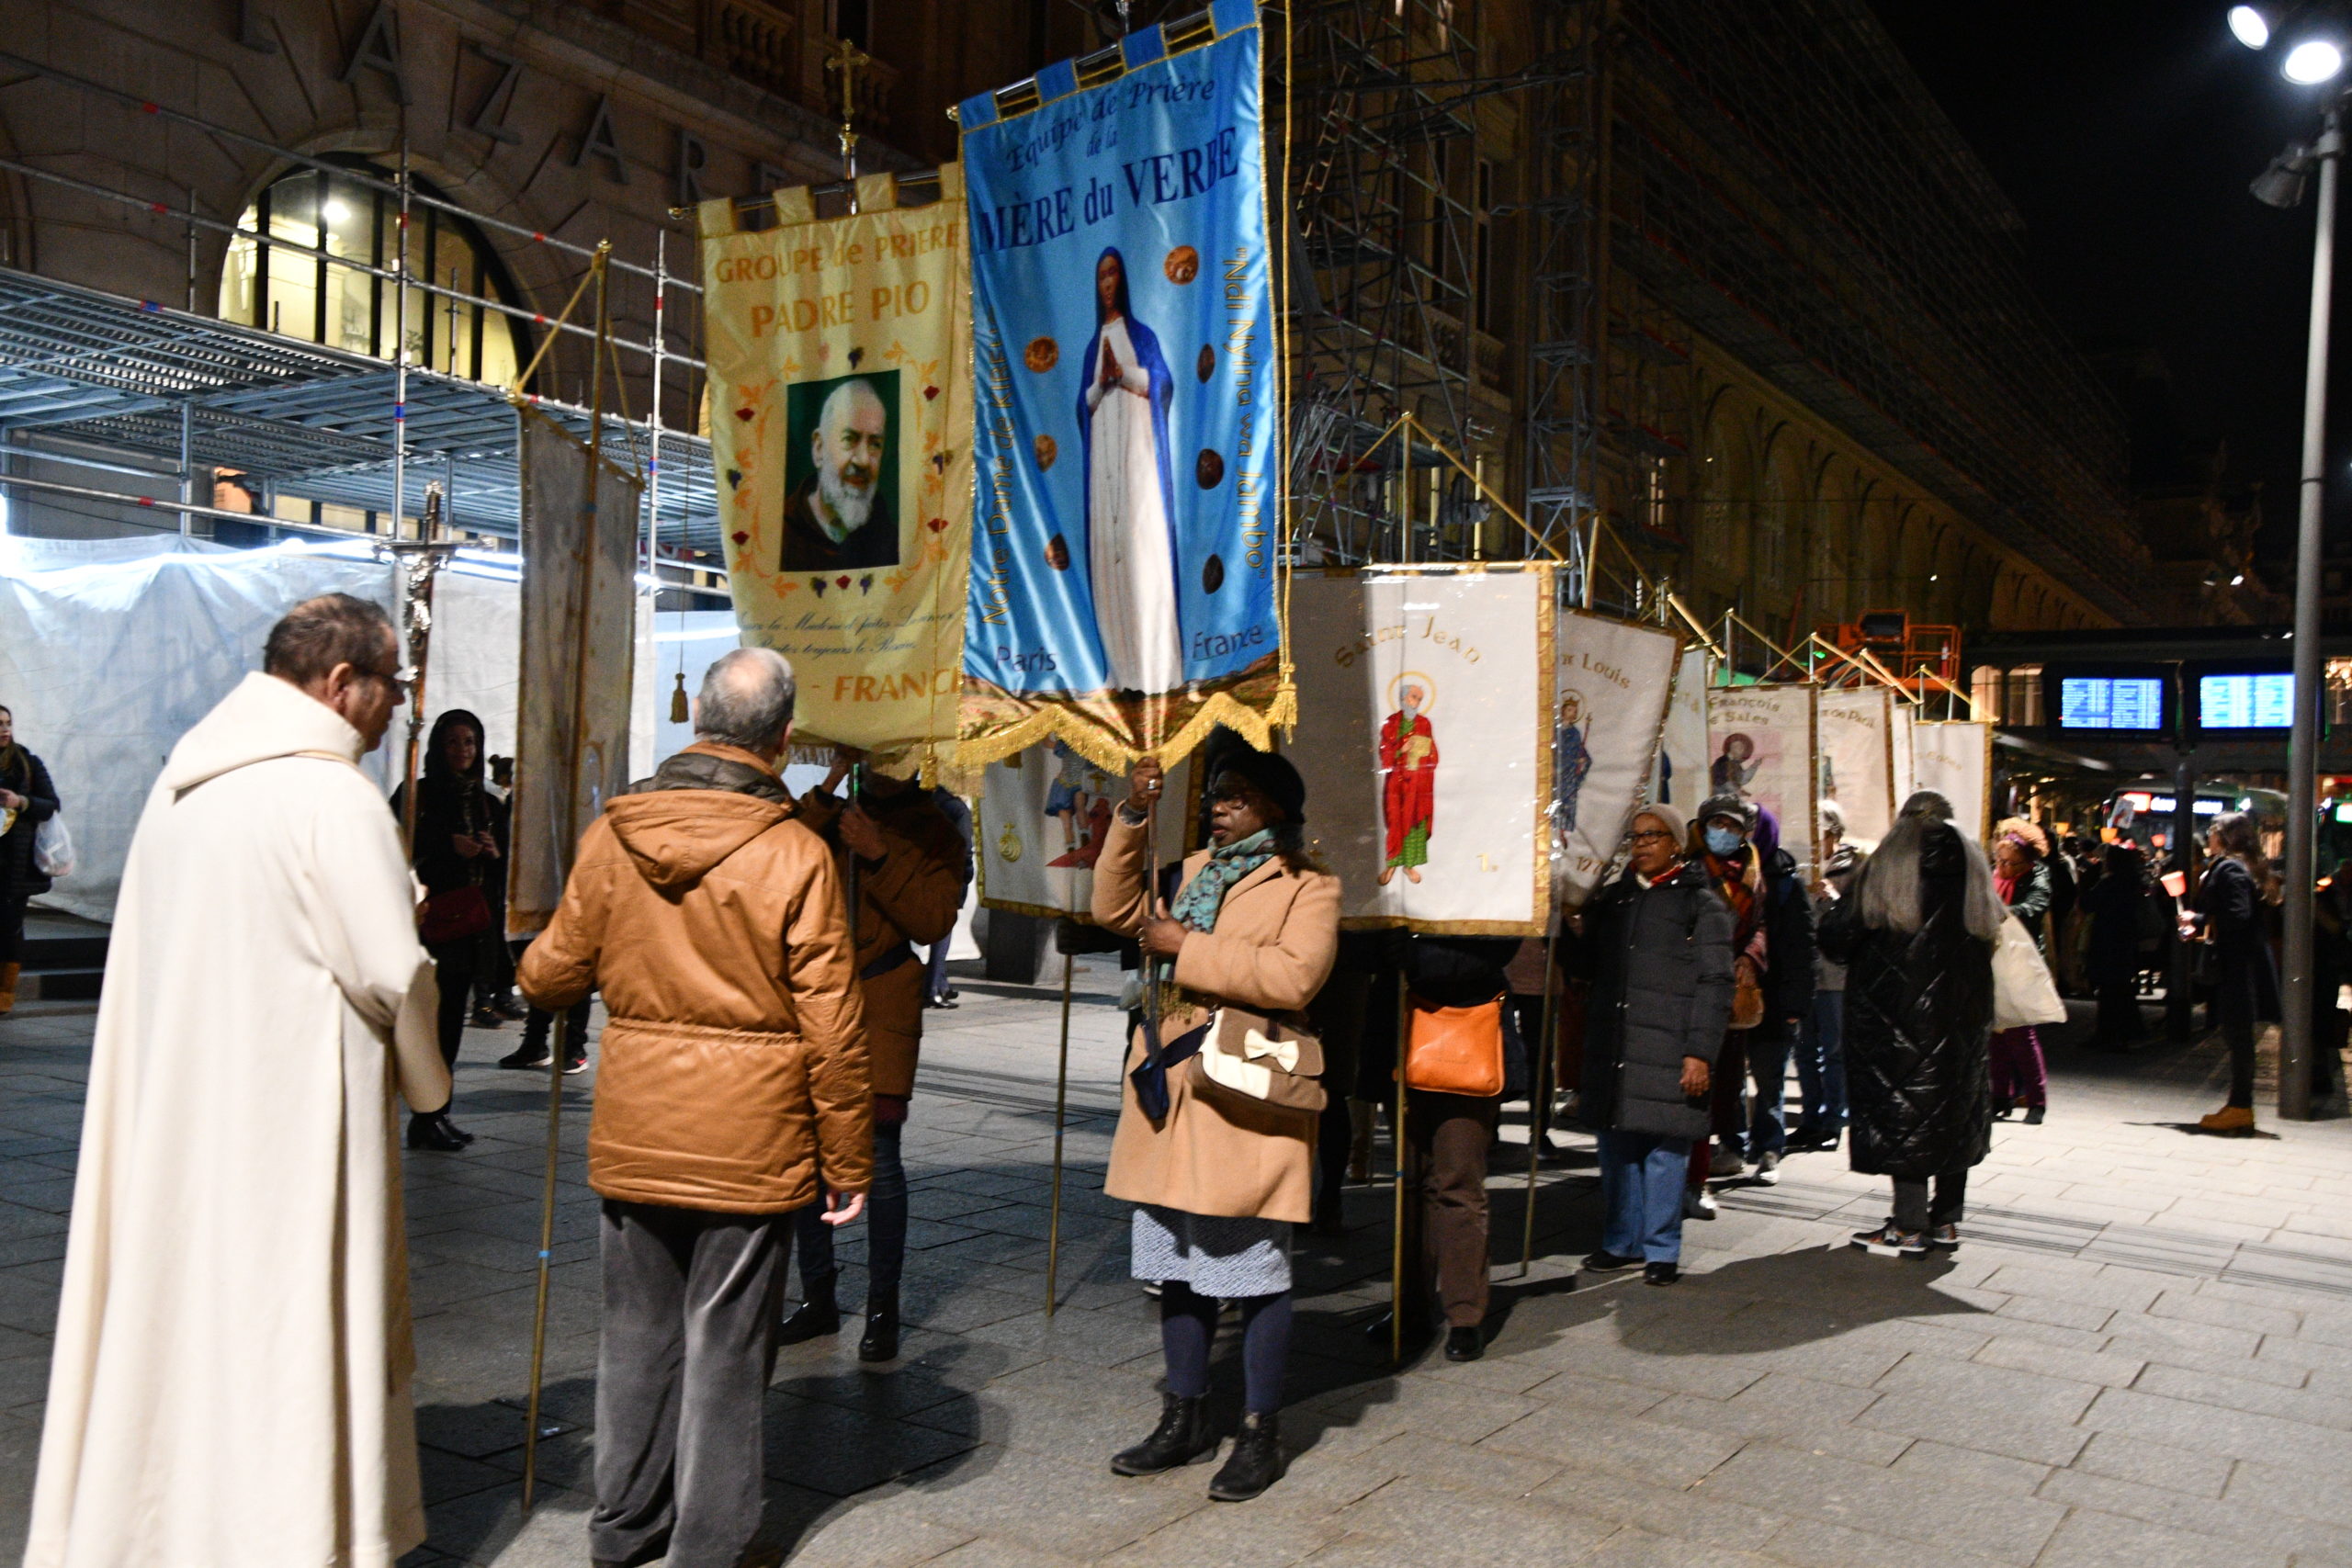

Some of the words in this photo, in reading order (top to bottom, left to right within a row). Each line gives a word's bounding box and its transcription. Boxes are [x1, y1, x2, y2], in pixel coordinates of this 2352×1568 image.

[1091, 93, 1118, 123] de
[1129, 75, 1216, 110] Prière
[979, 186, 1075, 253] MÈRE
[1084, 177, 1114, 226] du
[1123, 127, 1239, 209] VERBE
[715, 246, 823, 284] GROUPE
[834, 238, 863, 267] de
[749, 290, 854, 338] PADRE
[872, 279, 930, 321] PIO
[1223, 319, 1257, 406] Nyina
[989, 416, 1014, 448] de
[1237, 412, 1253, 457] wa
[982, 455, 1012, 626] Notre-Dame
[995, 645, 1057, 672] Paris
[1335, 624, 1407, 668] Saint
[1421, 614, 1481, 665] Jean
[1582, 653, 1631, 689] Louis
